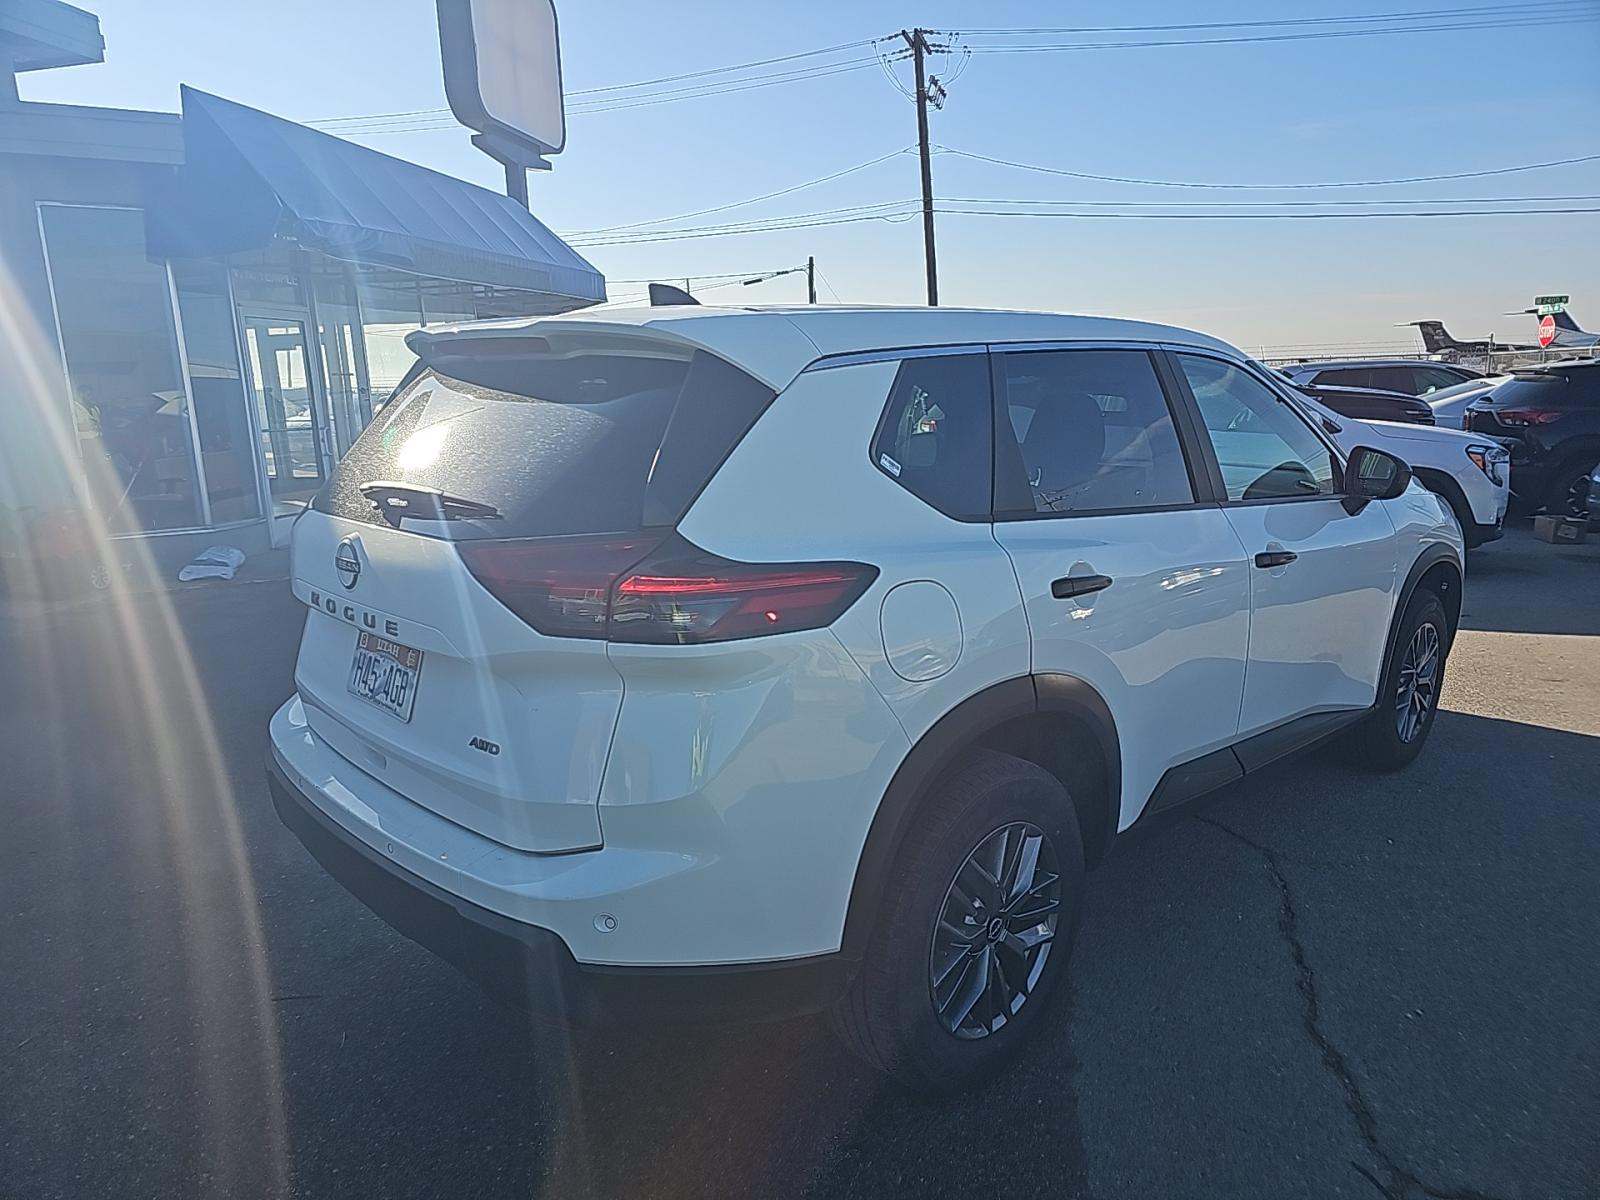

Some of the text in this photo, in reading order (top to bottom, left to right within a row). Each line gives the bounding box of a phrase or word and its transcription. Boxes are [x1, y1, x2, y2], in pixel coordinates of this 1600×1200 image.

[1540, 326, 1555, 338] STOP
[310, 591, 399, 637] ROGUE
[376, 638, 400, 657] UTAH
[468, 736, 501, 756] AWD
